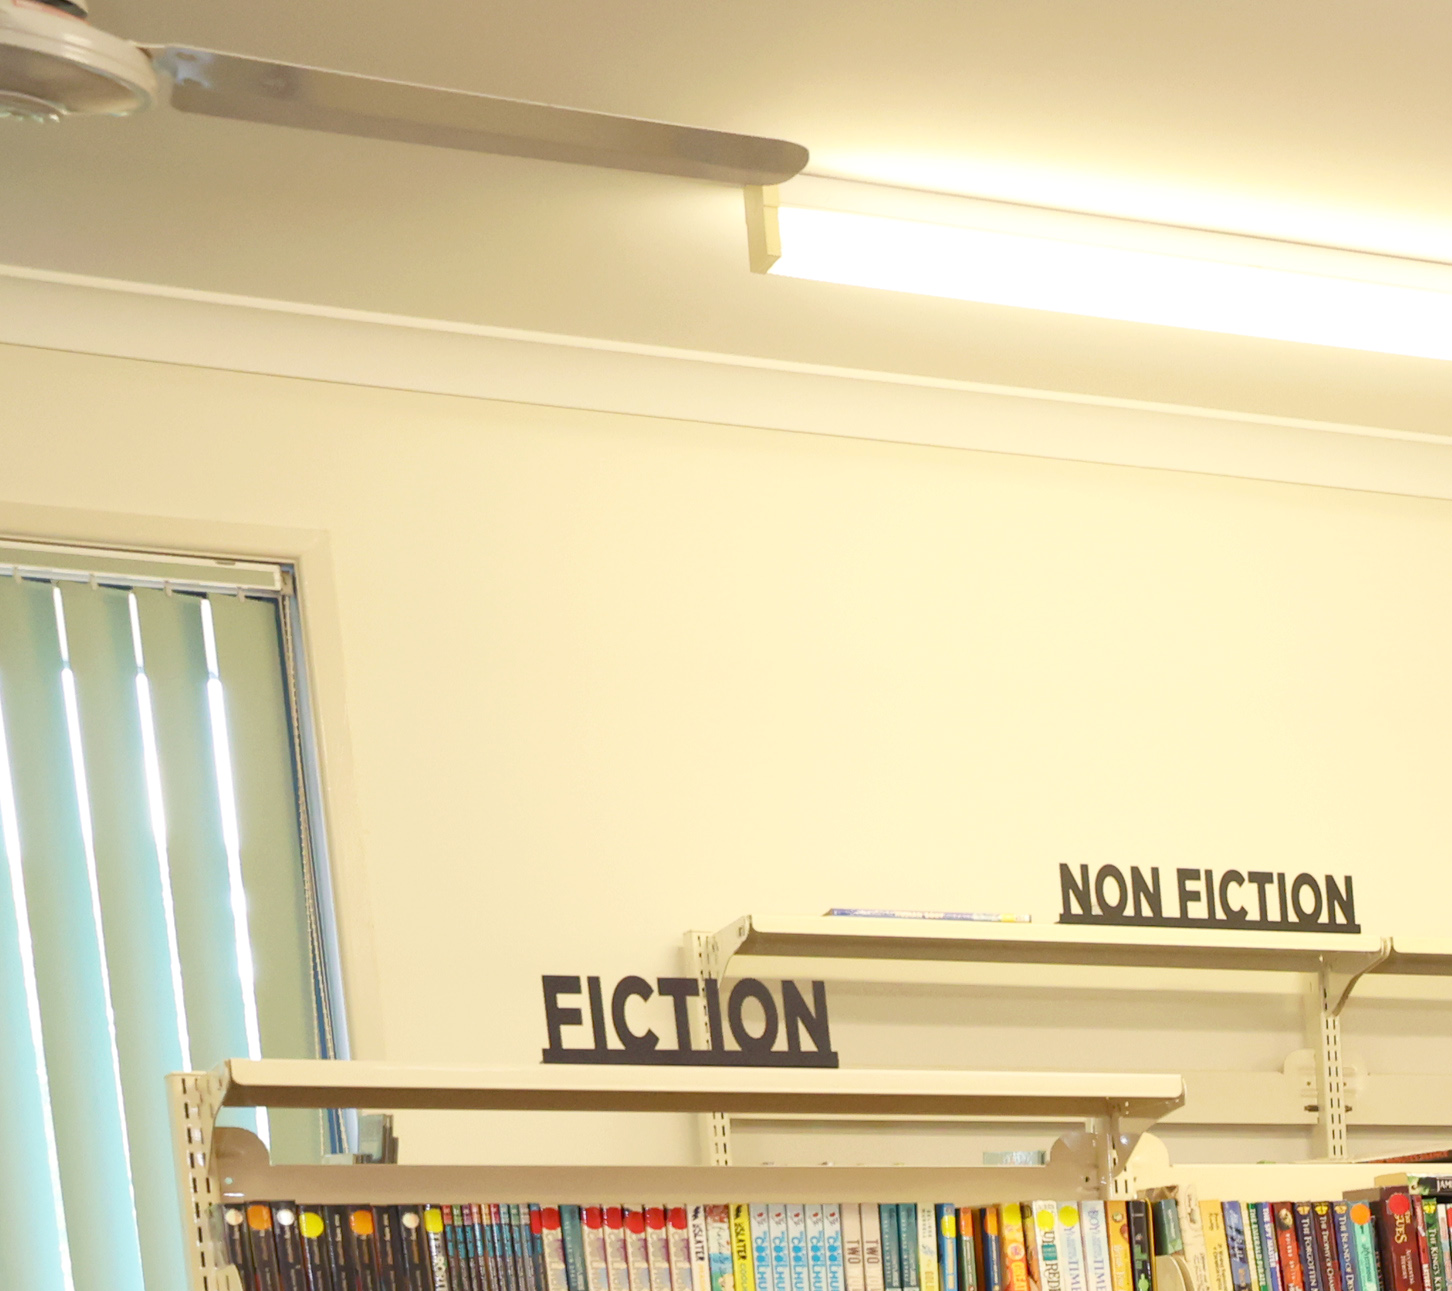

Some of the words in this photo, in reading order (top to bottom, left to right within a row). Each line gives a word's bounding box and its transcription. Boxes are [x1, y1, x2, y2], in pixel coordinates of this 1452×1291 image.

[1059, 863, 1161, 921] NON
[1176, 868, 1357, 929] FICTION
[542, 974, 834, 1055] FICTION
